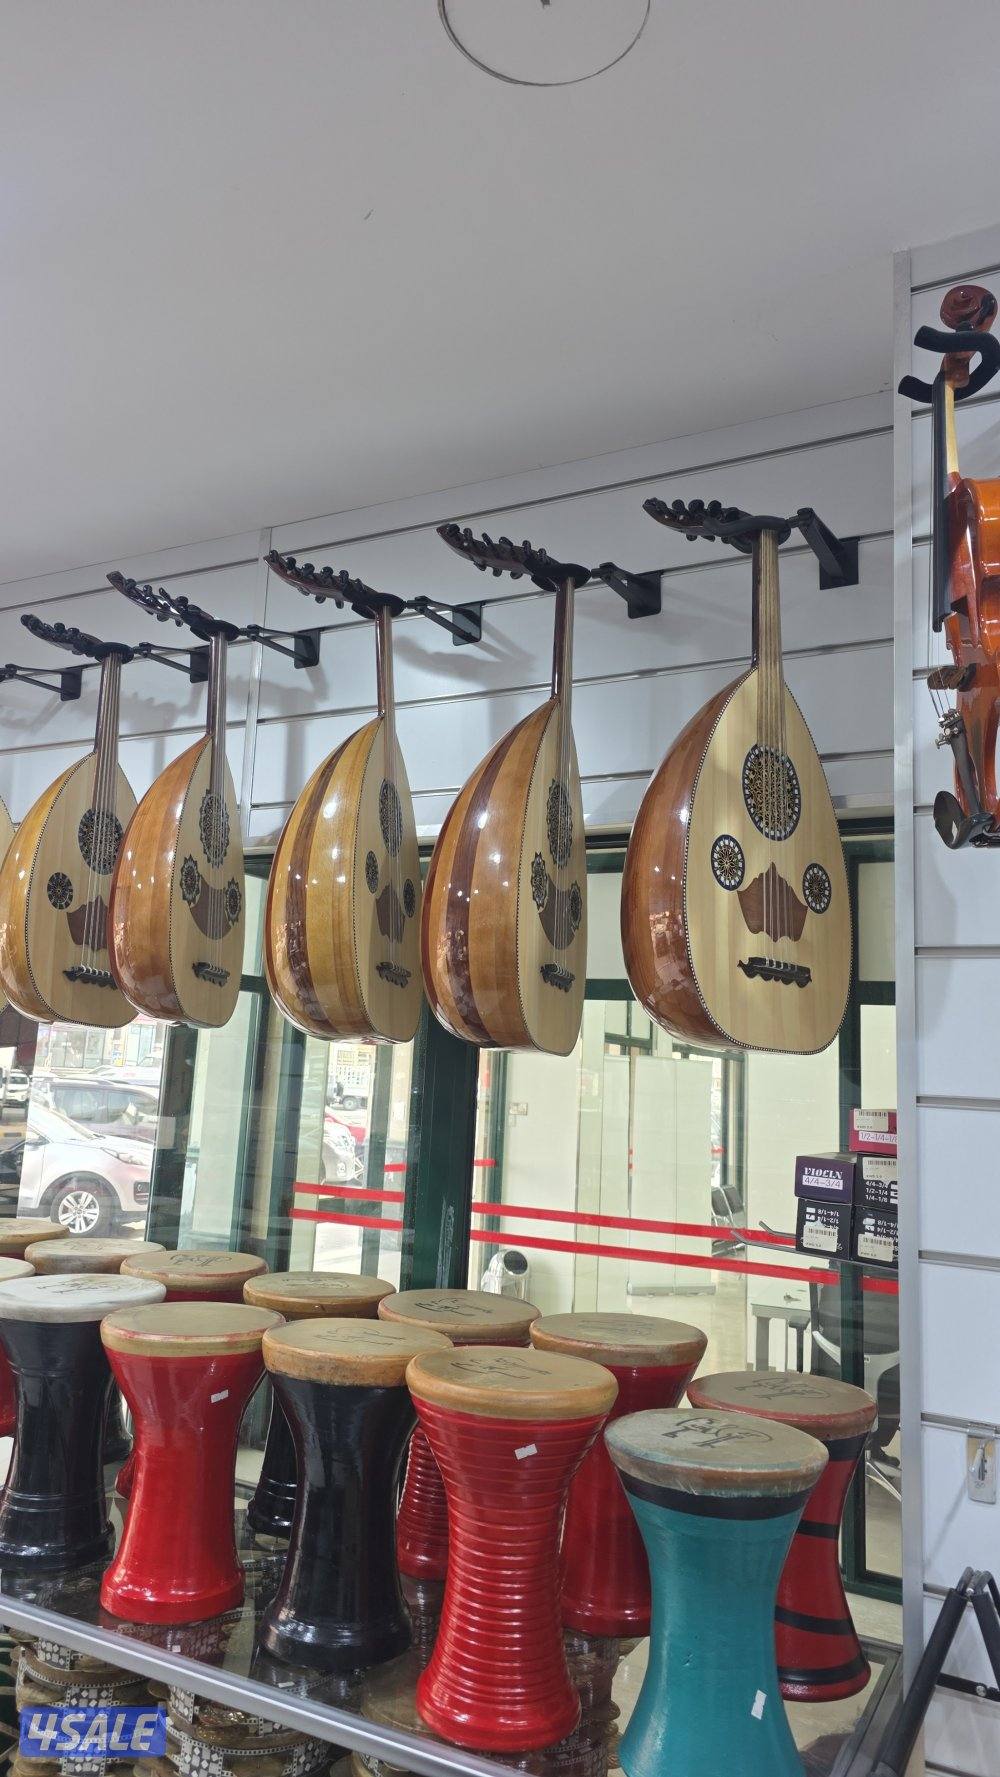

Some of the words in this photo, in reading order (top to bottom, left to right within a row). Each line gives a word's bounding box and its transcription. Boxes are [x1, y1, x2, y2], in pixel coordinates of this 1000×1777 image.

[804, 1177, 841, 1189] 4/4-3/4
[865, 1187, 888, 1196] 1/2-1/4
[865, 1194, 888, 1203] 1/4-1/8
[877, 1219, 897, 1228] /4-1/8
[877, 1226, 897, 1235] /2-1/4
